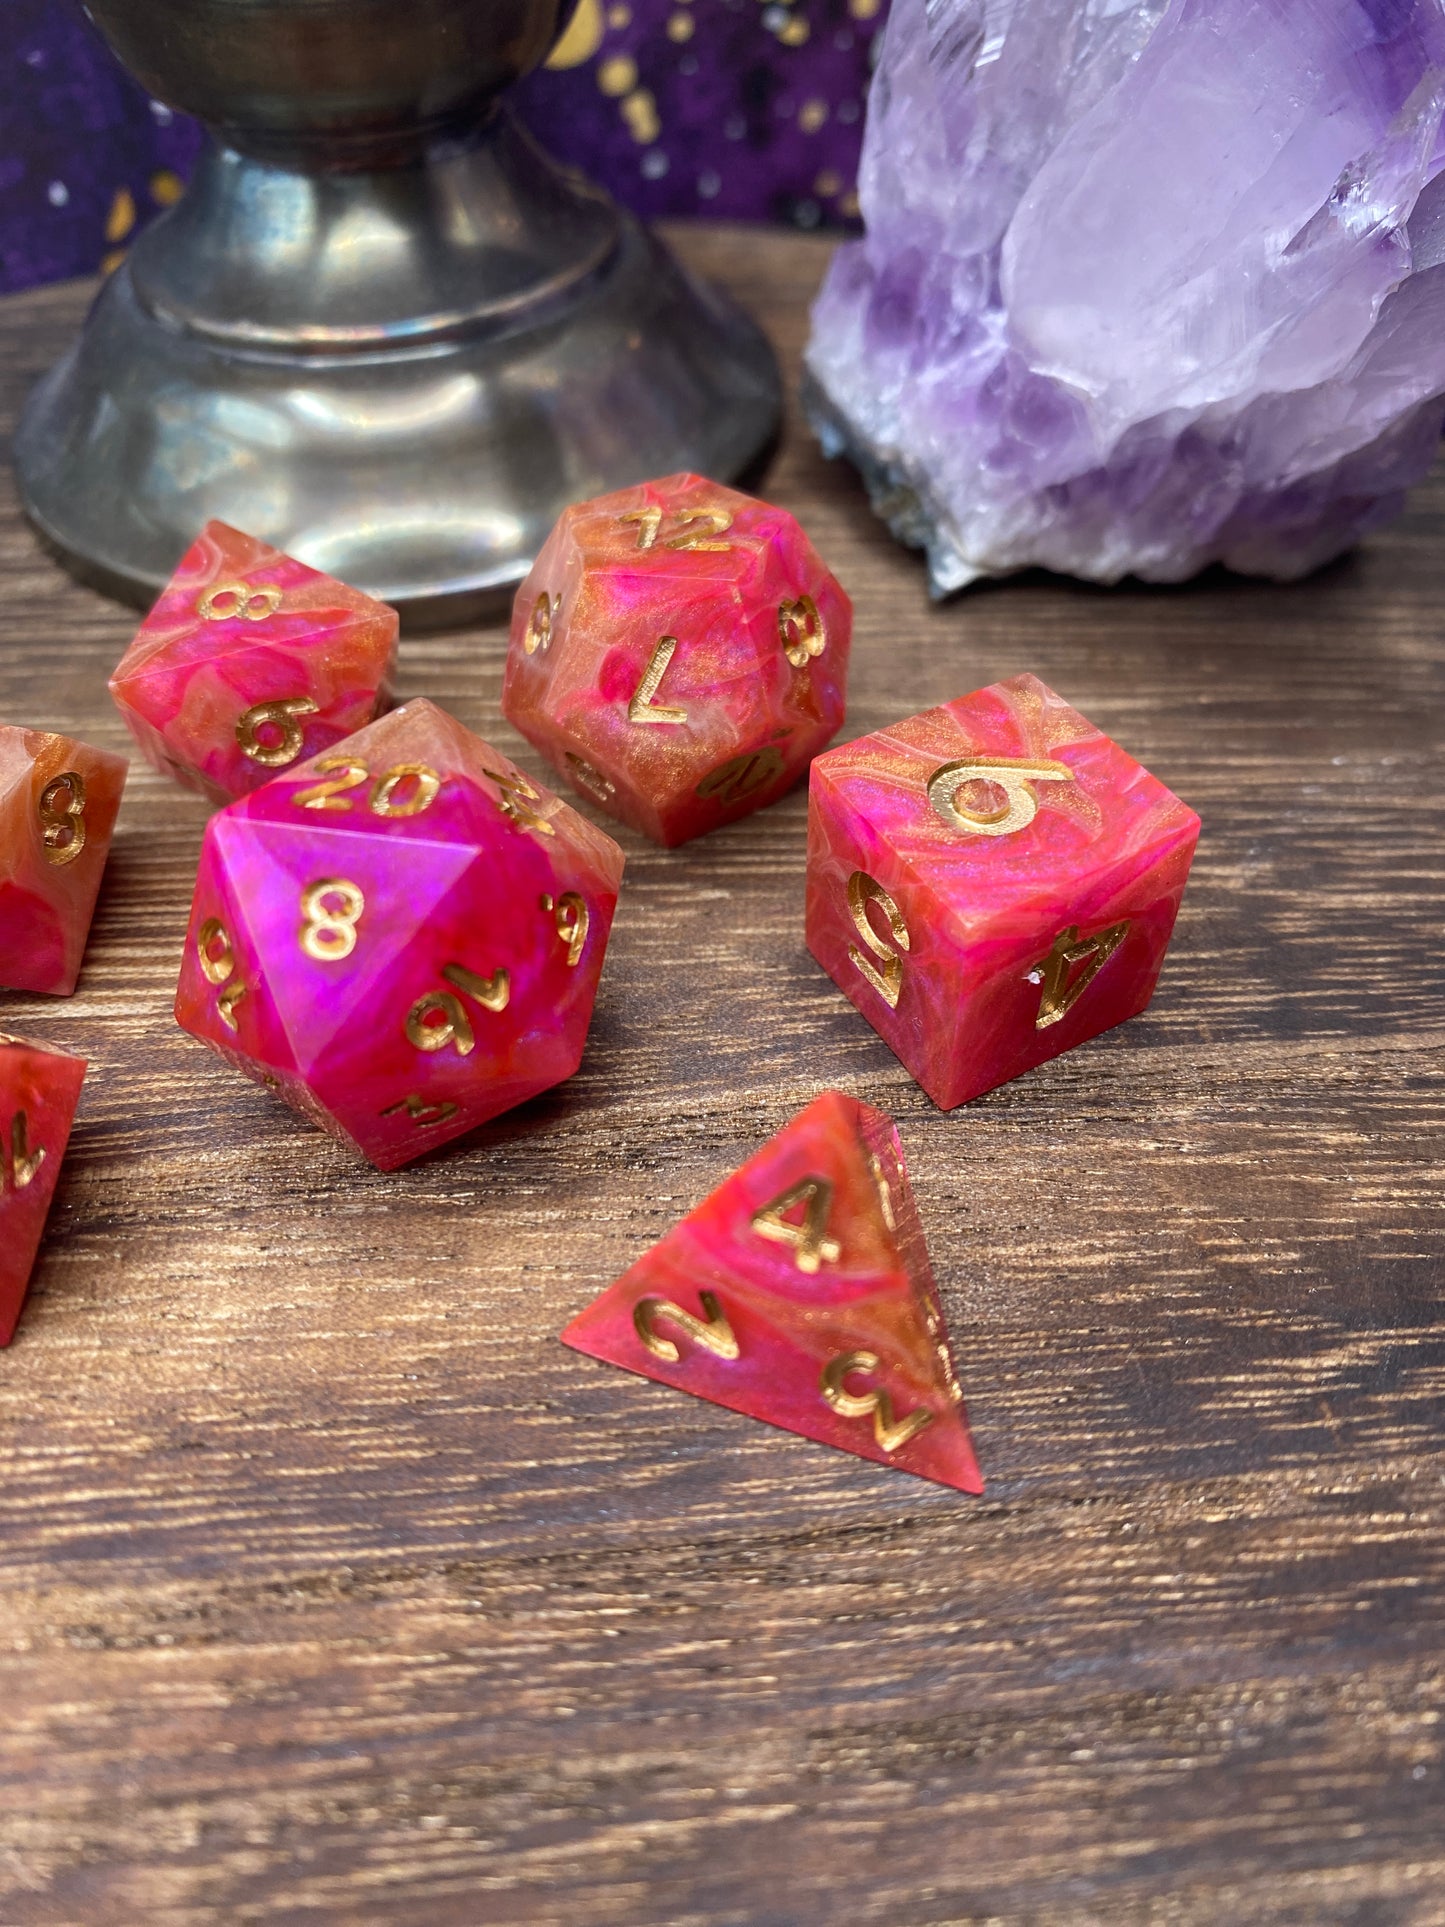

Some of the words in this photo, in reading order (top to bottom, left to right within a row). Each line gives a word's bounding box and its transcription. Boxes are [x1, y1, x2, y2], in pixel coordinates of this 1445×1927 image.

[618, 505, 733, 551] 12
[197, 579, 283, 621] 8
[628, 635, 688, 724] 7
[235, 696, 320, 767] 6
[291, 755, 442, 817] 20
[928, 757, 1076, 837] 6
[300, 878, 365, 962] 8
[847, 870, 911, 1010] 5
[1034, 919, 1132, 1031] 4
[751, 1174, 841, 1275] 4
[632, 1290, 740, 1363] 2
[820, 1350, 936, 1453] 3
